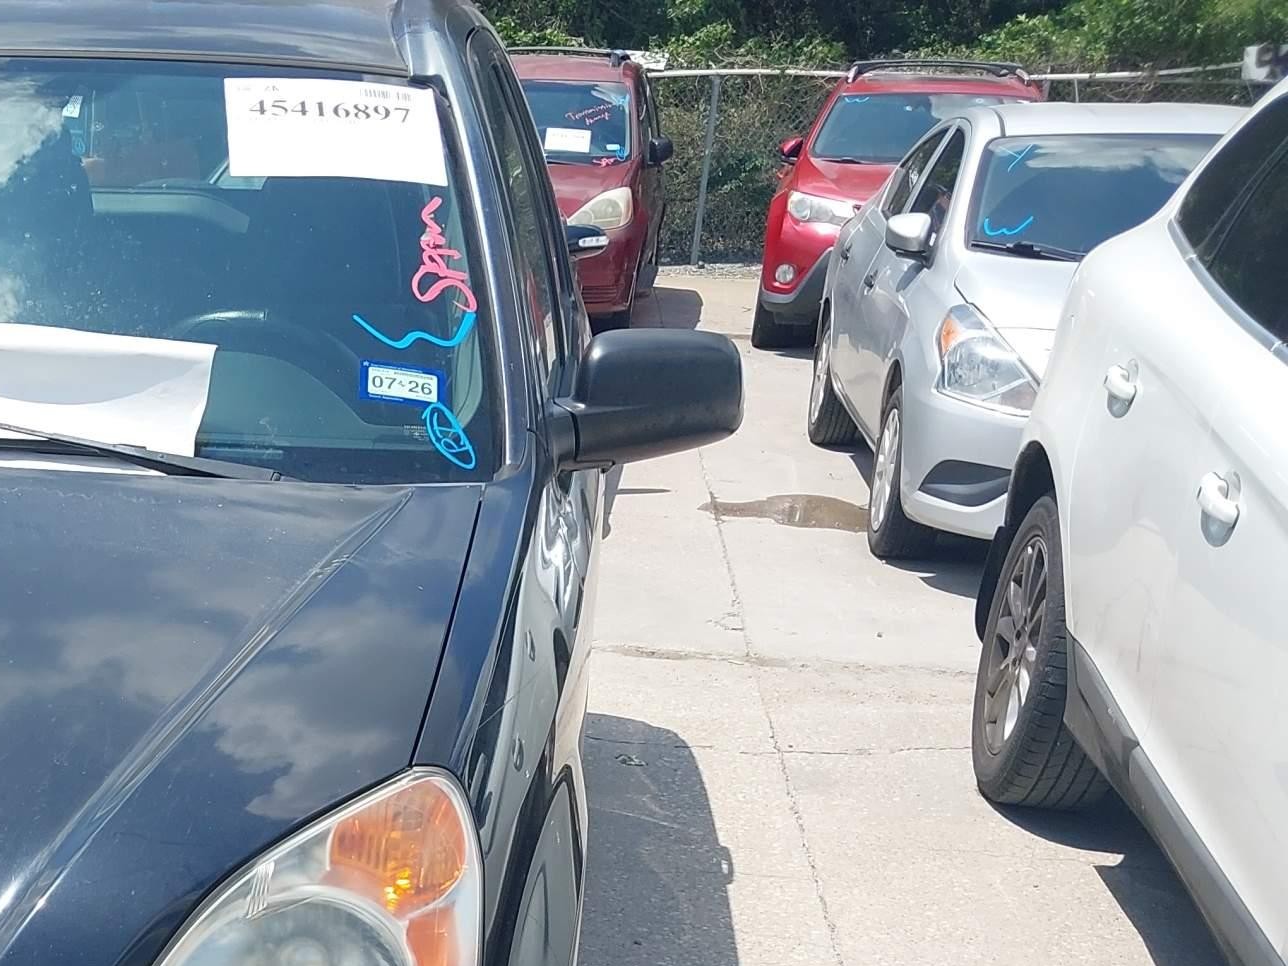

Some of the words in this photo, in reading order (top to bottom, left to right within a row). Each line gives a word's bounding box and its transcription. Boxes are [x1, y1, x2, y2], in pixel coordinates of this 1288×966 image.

[248, 99, 411, 124] 45416897
[372, 375, 397, 390] 07
[407, 380, 433, 396] 26
